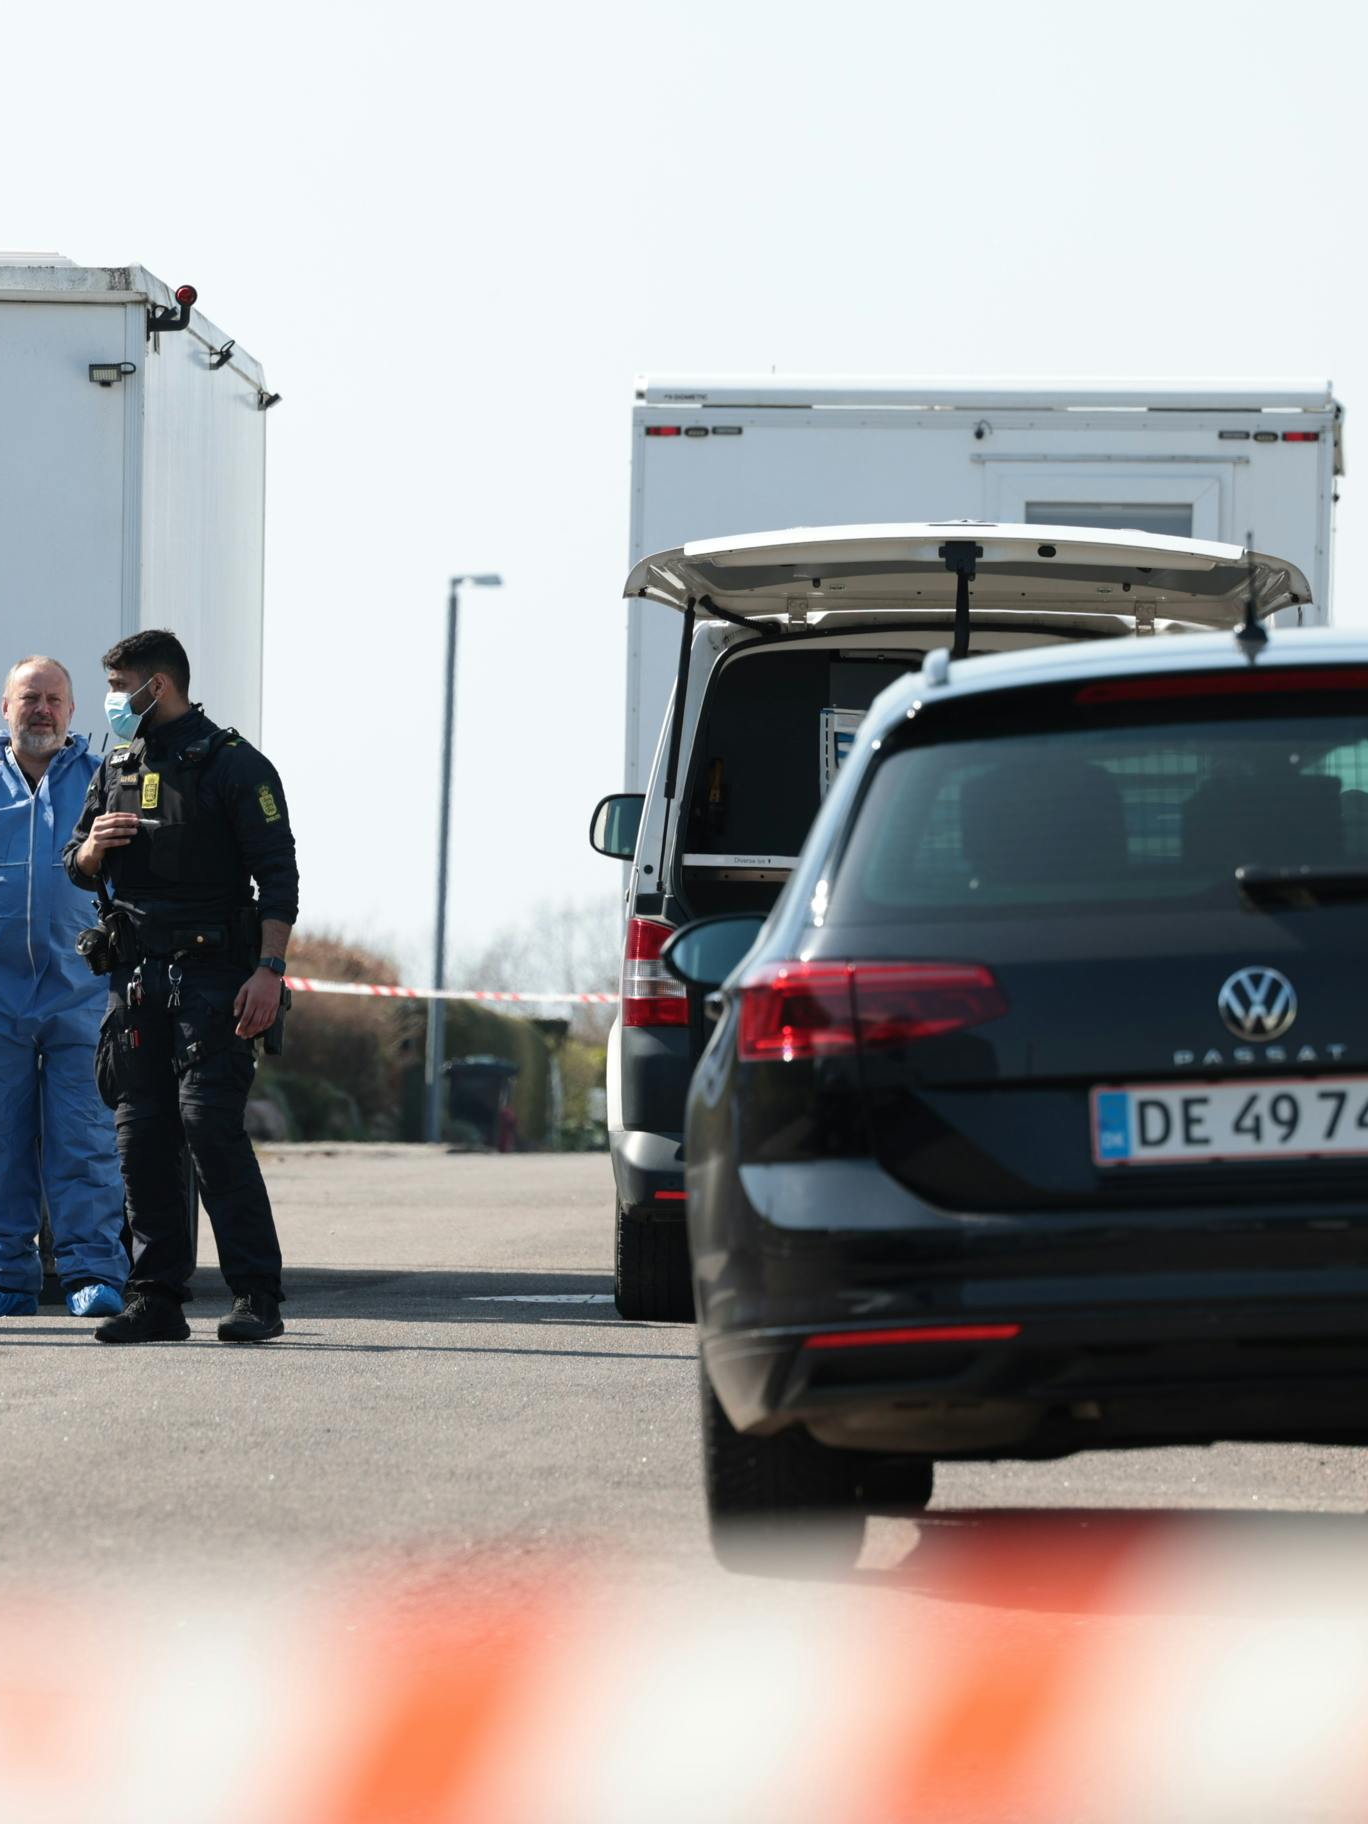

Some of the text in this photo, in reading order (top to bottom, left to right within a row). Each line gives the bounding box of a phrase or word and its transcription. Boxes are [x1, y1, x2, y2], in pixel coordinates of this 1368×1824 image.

[1173, 1043, 1347, 1066] PASSAT
[1137, 1096, 1212, 1148] DE
[1232, 1092, 1301, 1145] 49
